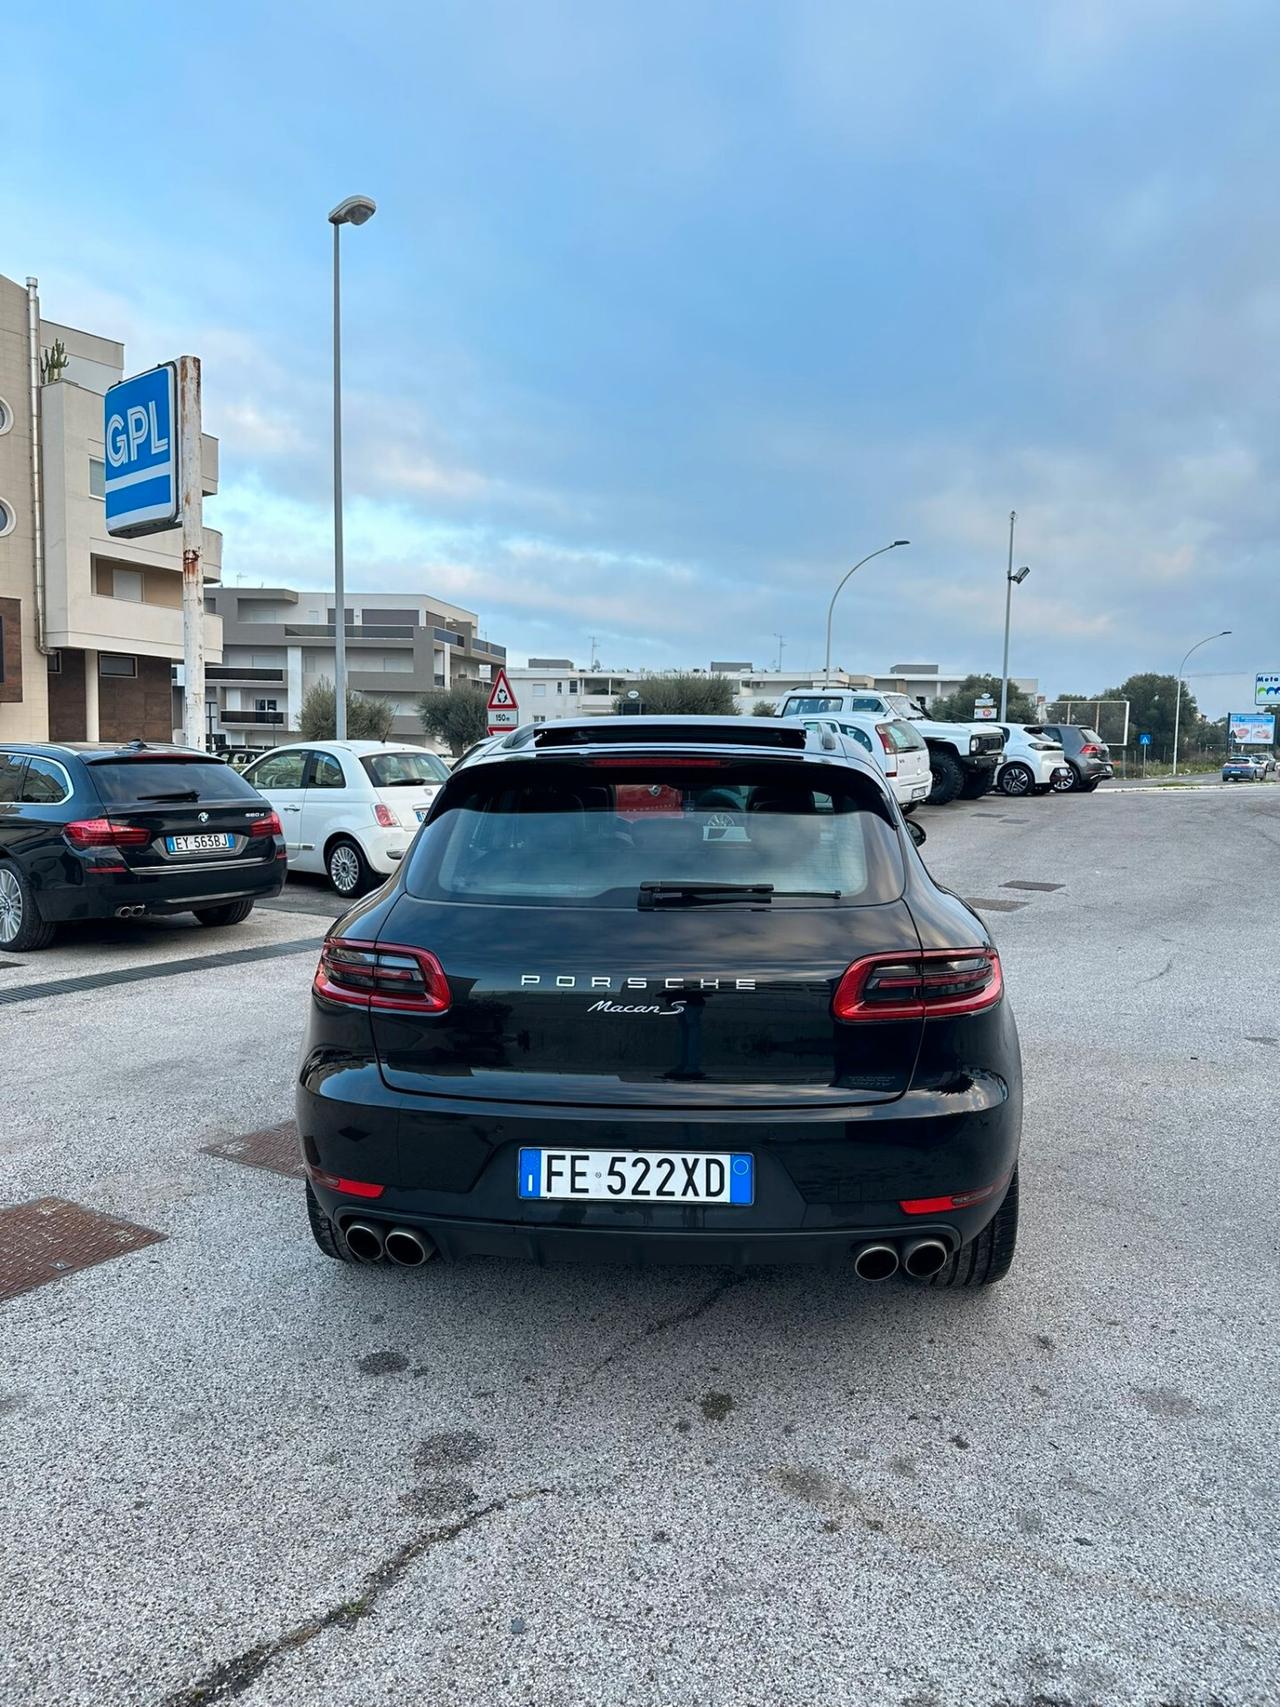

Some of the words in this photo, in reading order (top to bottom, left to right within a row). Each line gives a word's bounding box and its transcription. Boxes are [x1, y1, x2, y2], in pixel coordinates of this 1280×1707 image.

[107, 400, 169, 467] GPL
[174, 836, 189, 850] EY
[194, 833, 227, 848] 563BJ
[520, 974, 757, 991] PORSCHE
[586, 1000, 661, 1014] Macan
[659, 1000, 688, 1016] S
[546, 1154, 590, 1194] FE
[607, 1156, 726, 1198] 522XD
